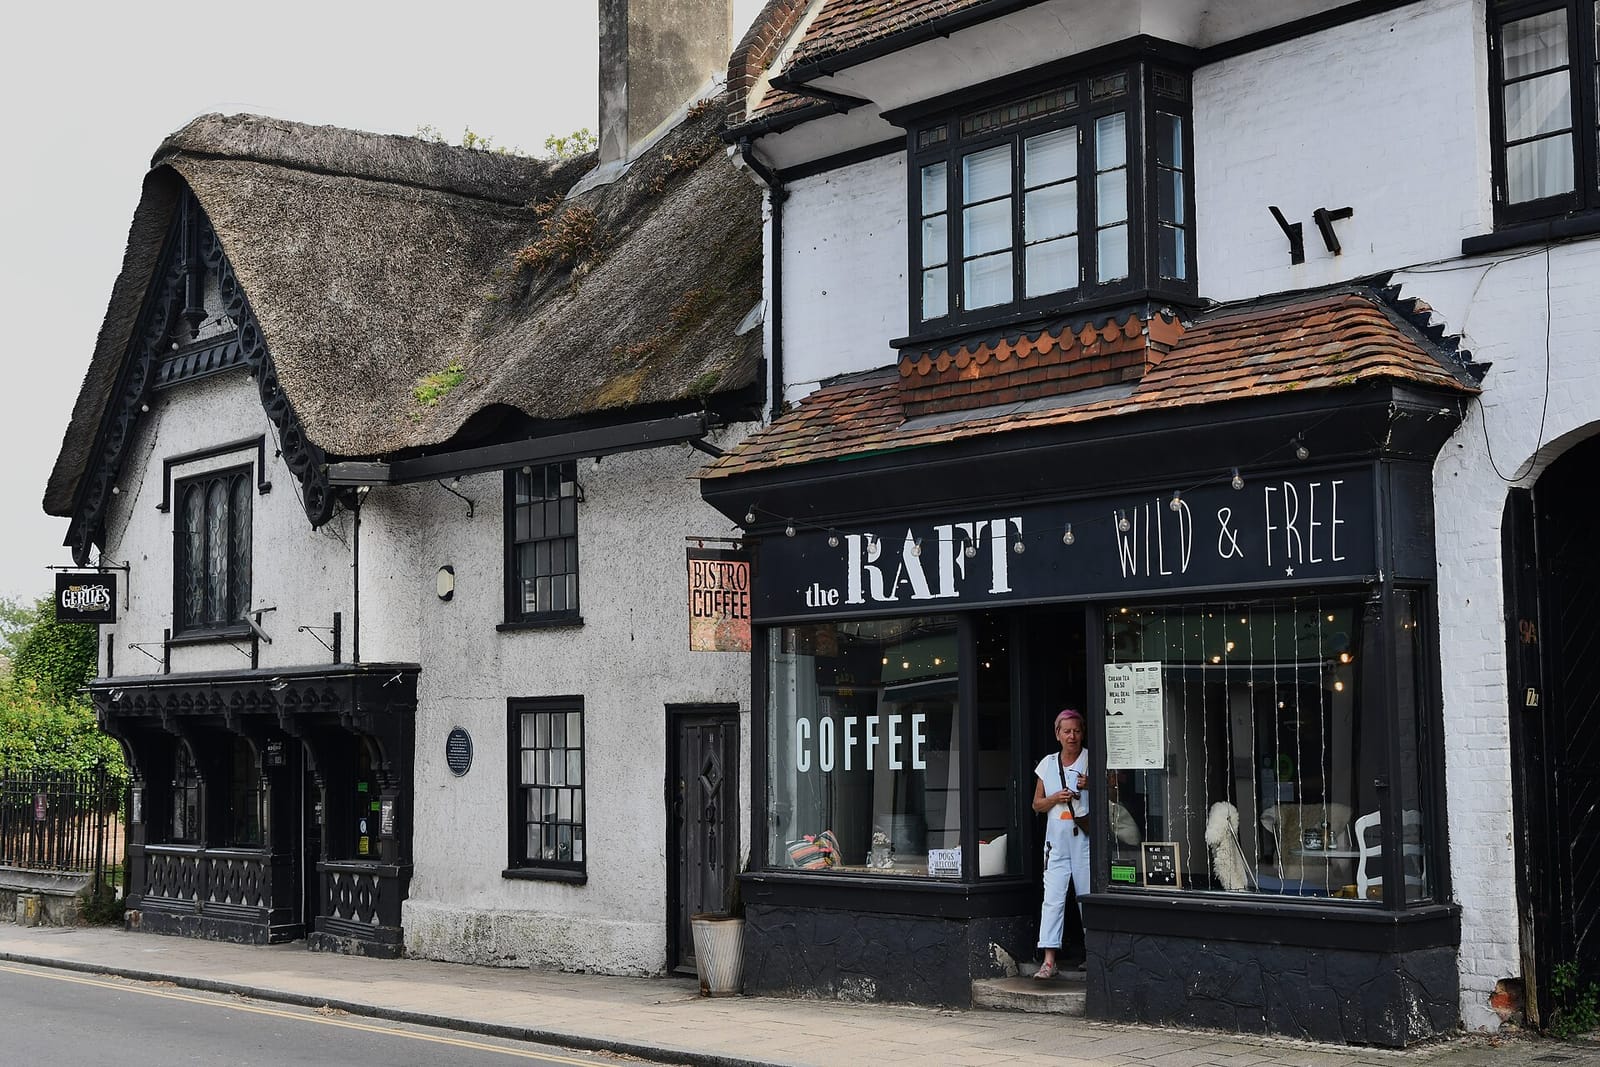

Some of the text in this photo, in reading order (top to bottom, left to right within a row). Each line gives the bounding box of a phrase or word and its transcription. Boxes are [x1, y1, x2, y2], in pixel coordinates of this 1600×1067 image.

[1113, 480, 1345, 578] WILD & FREE
[693, 561, 747, 591] BISTRO
[805, 516, 1022, 607] the RAFT
[693, 589, 748, 619] COFFEE
[796, 713, 926, 772] COFFEE
[938, 852, 954, 860] DOGS
